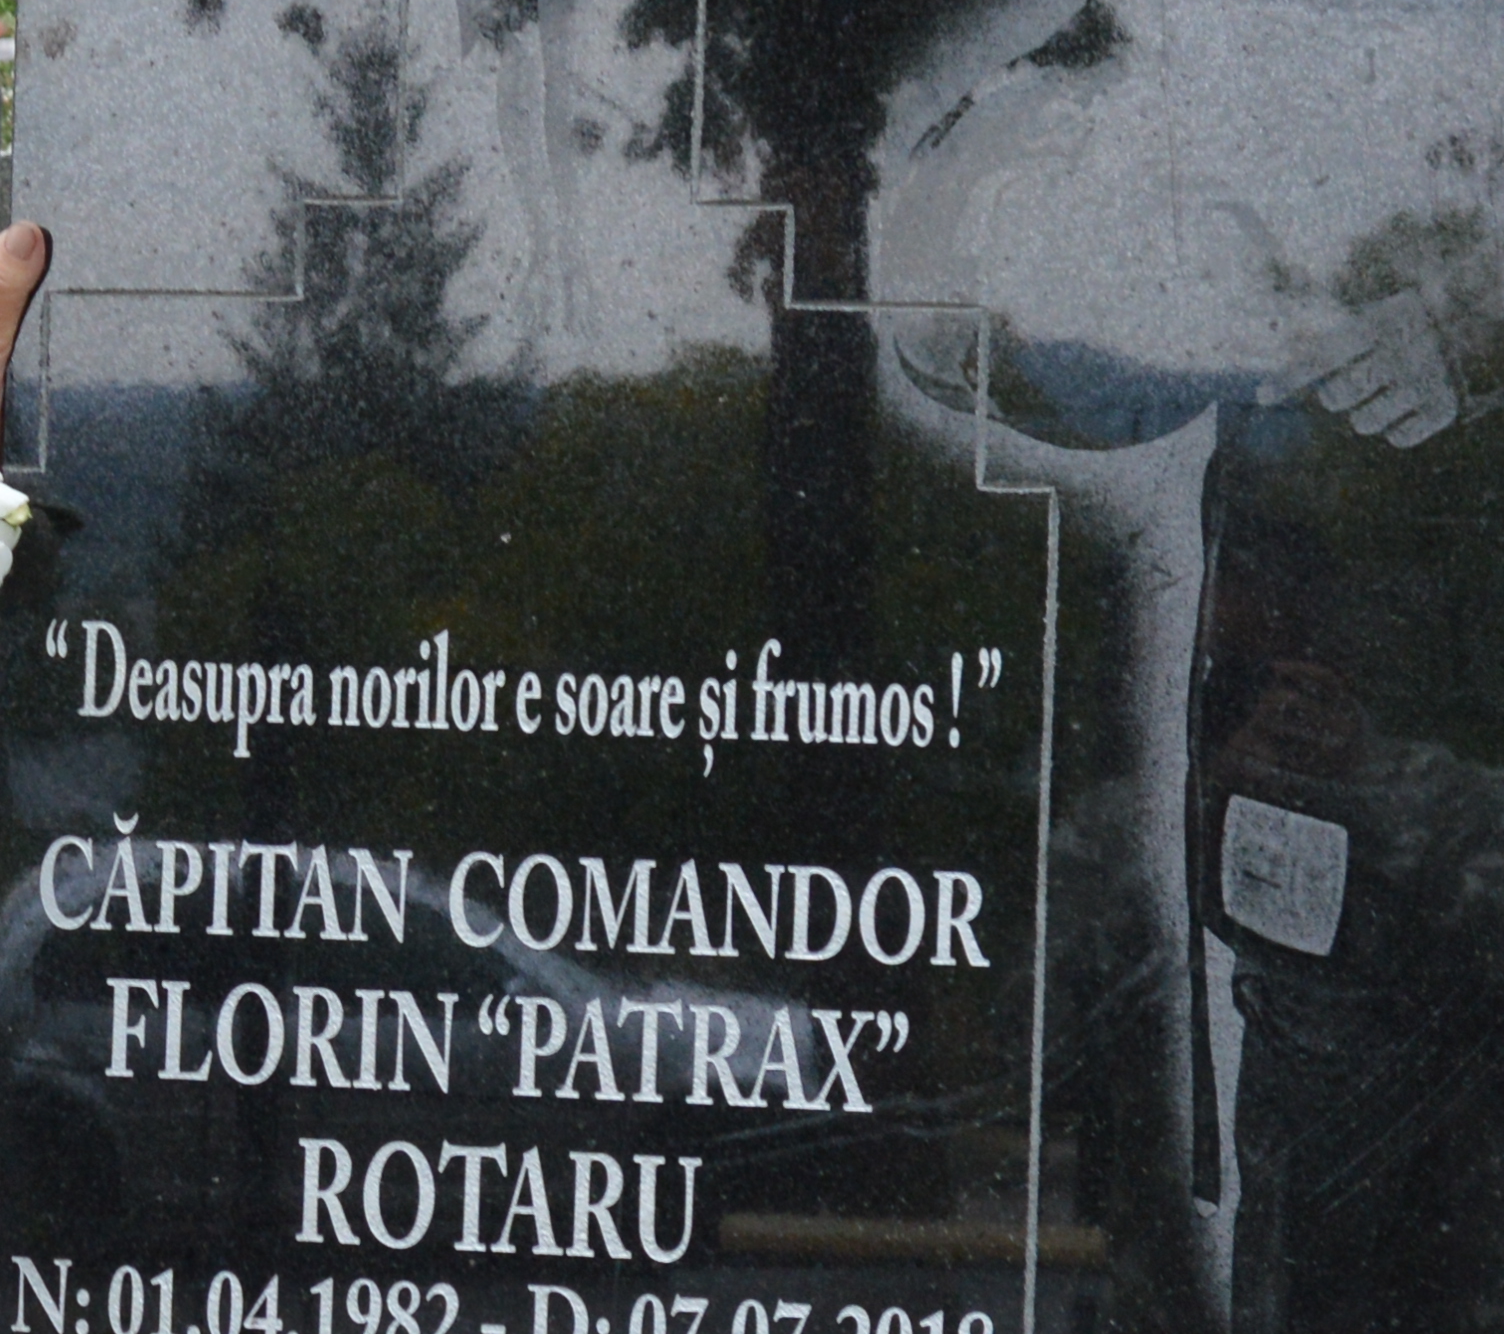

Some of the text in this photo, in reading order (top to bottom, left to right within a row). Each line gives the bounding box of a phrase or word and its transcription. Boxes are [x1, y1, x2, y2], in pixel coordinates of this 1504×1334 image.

[329, 629, 505, 735] norilor
[515, 682, 543, 736] e
[554, 679, 685, 742] soare
[698, 649, 740, 776] și
[39, 812, 991, 969] CĂPITAN COMANDOR
[104, 975, 910, 1115] FLORIN “PATRAX”
[295, 1135, 704, 1265] ROTARU
